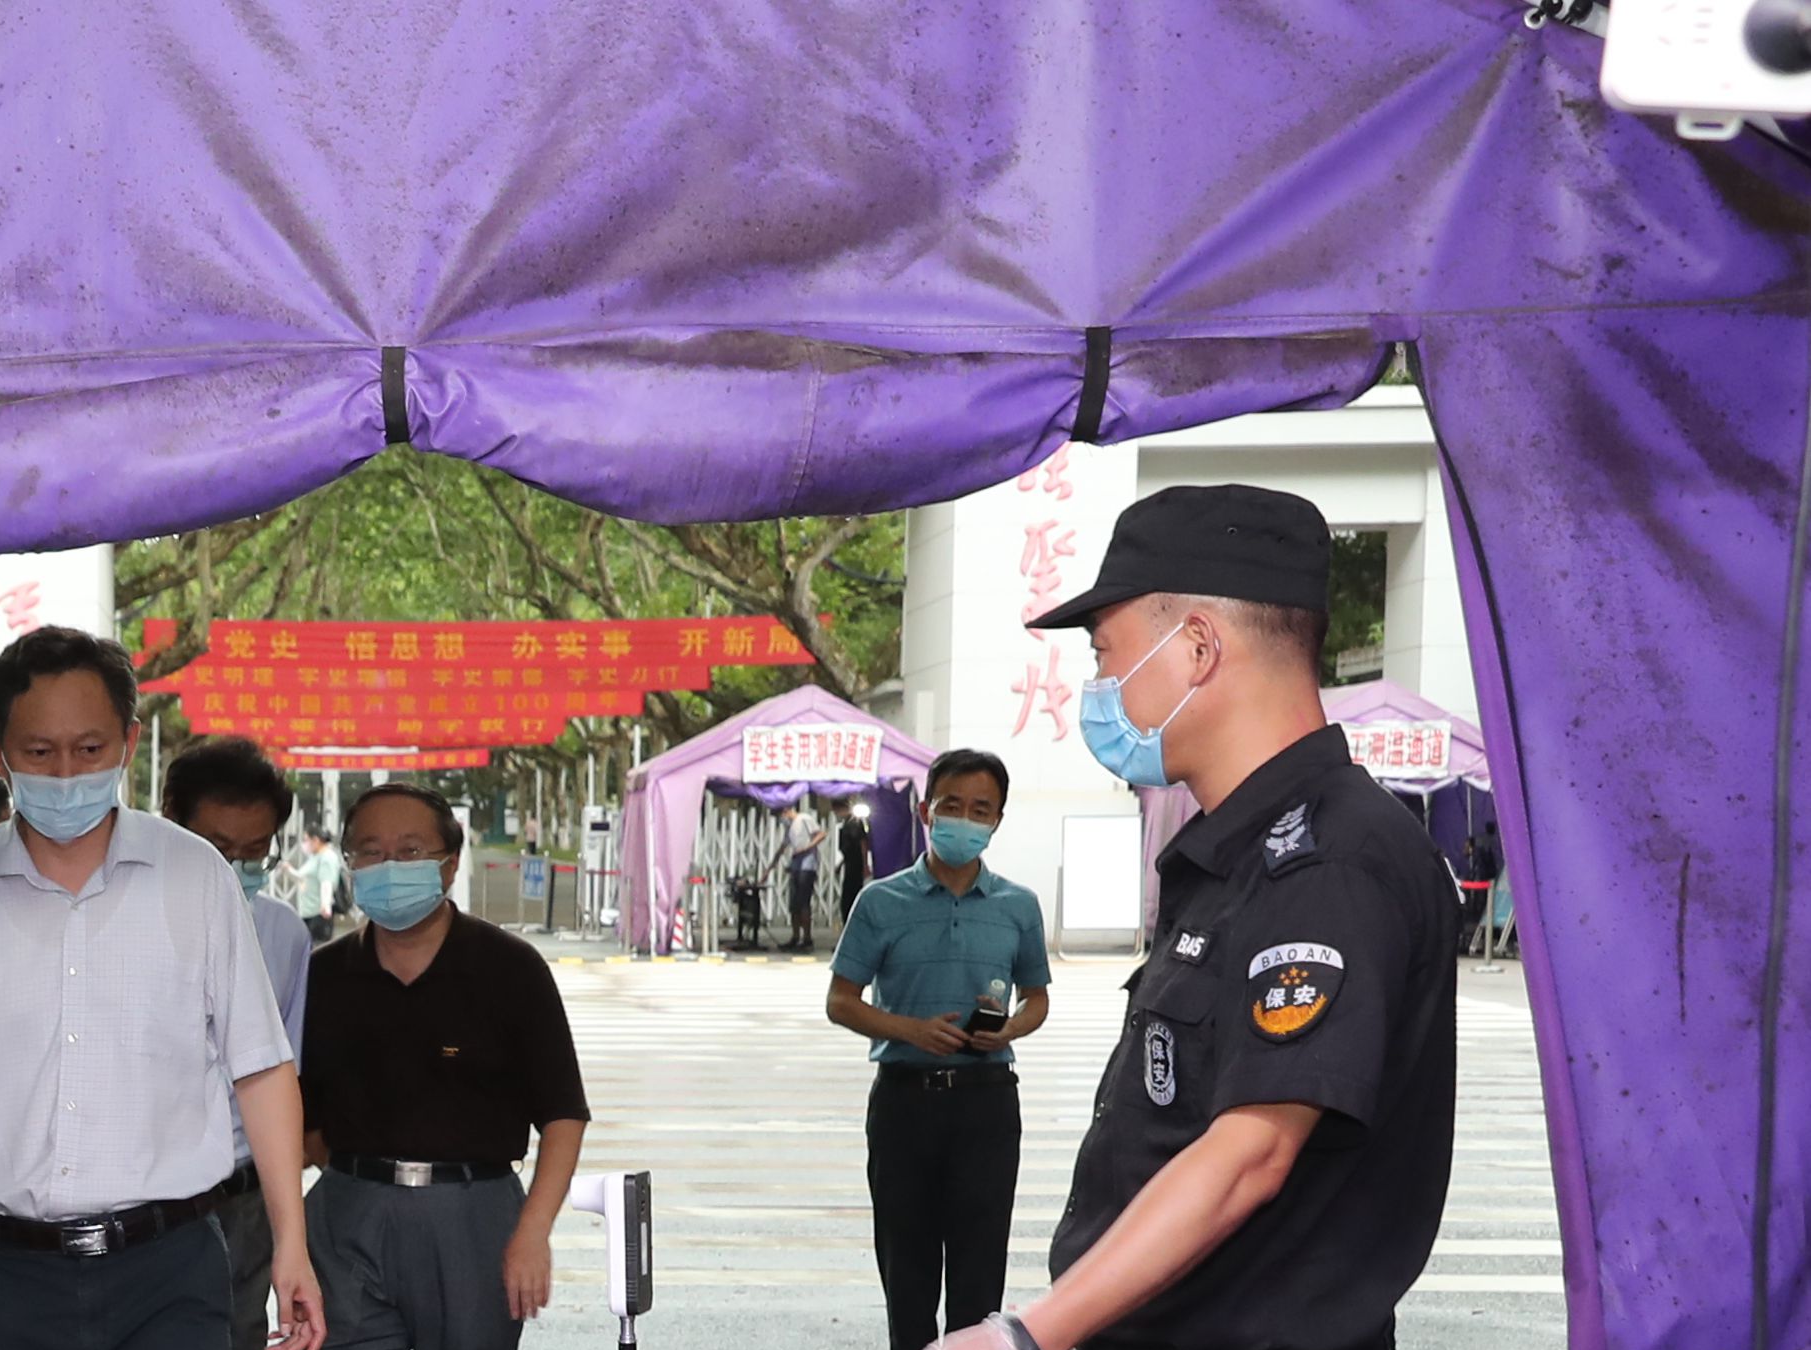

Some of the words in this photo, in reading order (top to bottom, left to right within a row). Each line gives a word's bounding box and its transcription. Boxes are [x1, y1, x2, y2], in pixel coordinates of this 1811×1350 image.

[206, 629, 300, 660] 党史
[344, 631, 466, 661] 悟思想
[511, 630, 633, 660] 办实事
[678, 625, 799, 657] 开新局
[568, 665, 680, 686] 学史力行
[748, 731, 877, 772] 学生专用测温通道
[1265, 984, 1317, 1009] 保安
